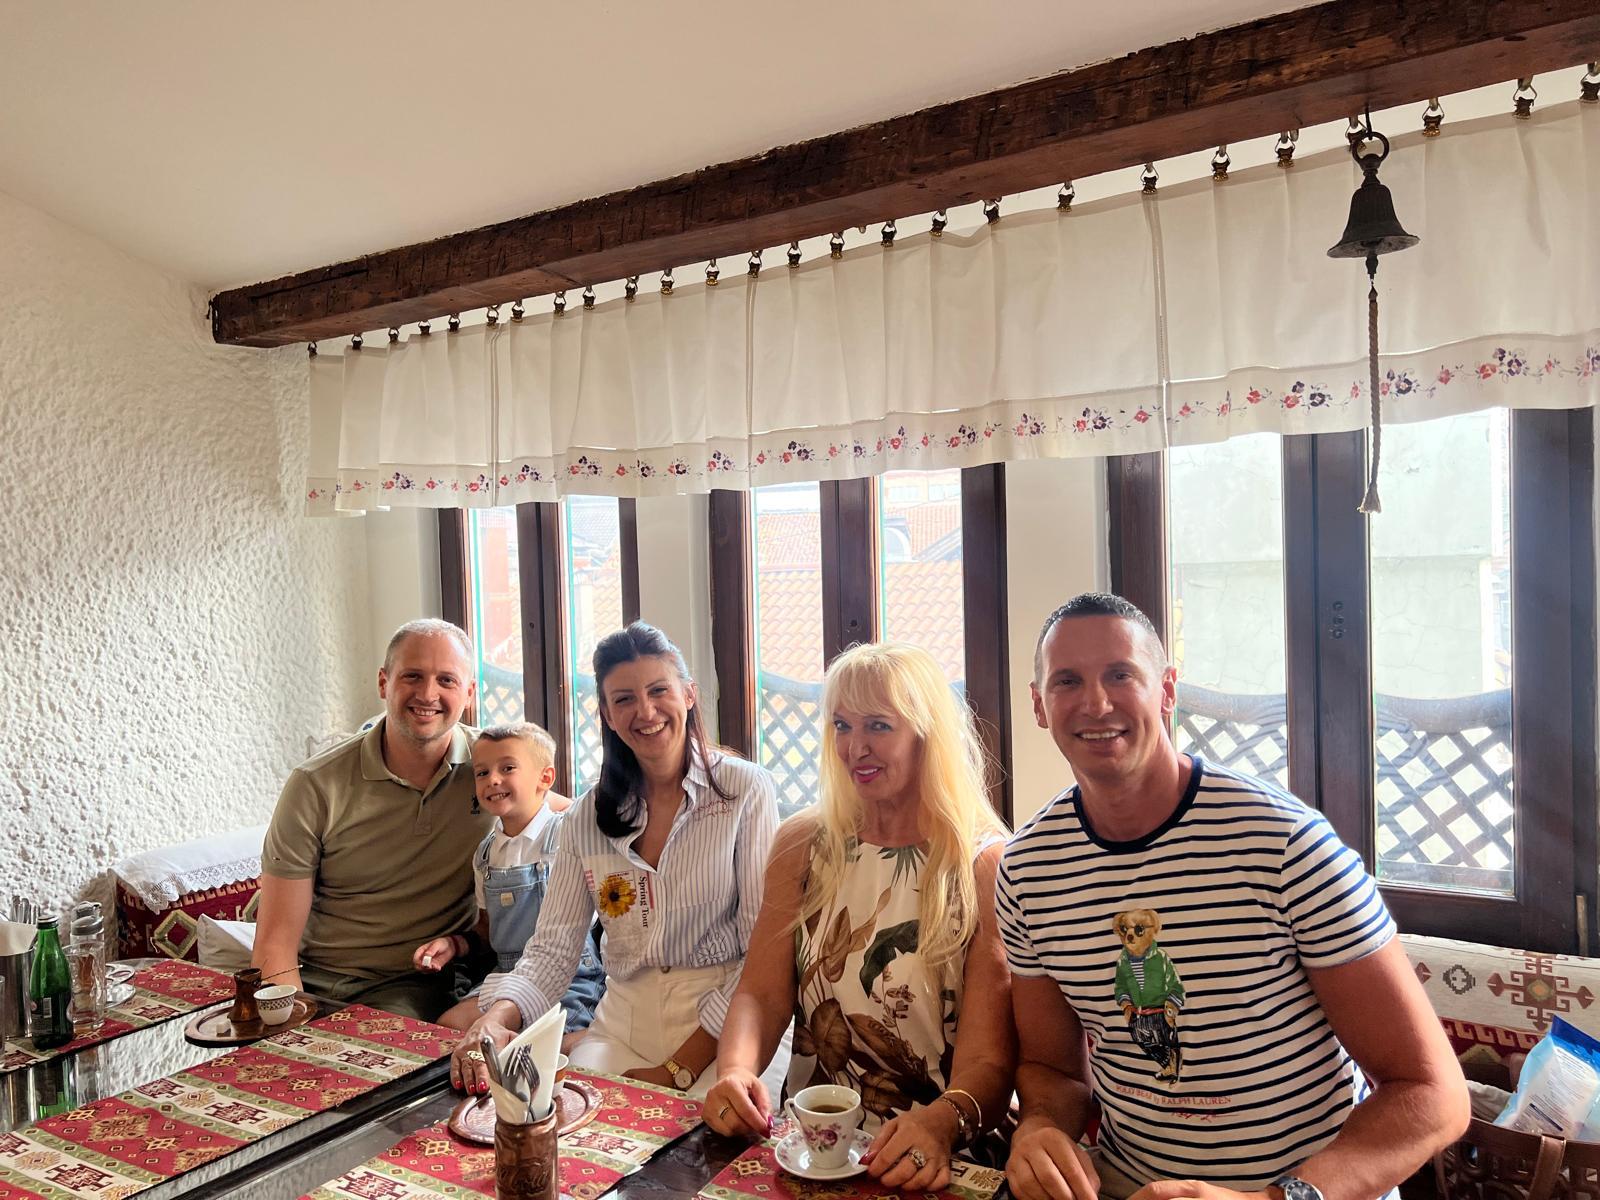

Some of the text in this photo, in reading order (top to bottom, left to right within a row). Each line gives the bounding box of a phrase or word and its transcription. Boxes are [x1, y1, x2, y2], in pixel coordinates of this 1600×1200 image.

[638, 876, 649, 928] Spring Tour
[1161, 1096, 1191, 1105] RALPH
[1192, 1096, 1232, 1106] LAUREN
